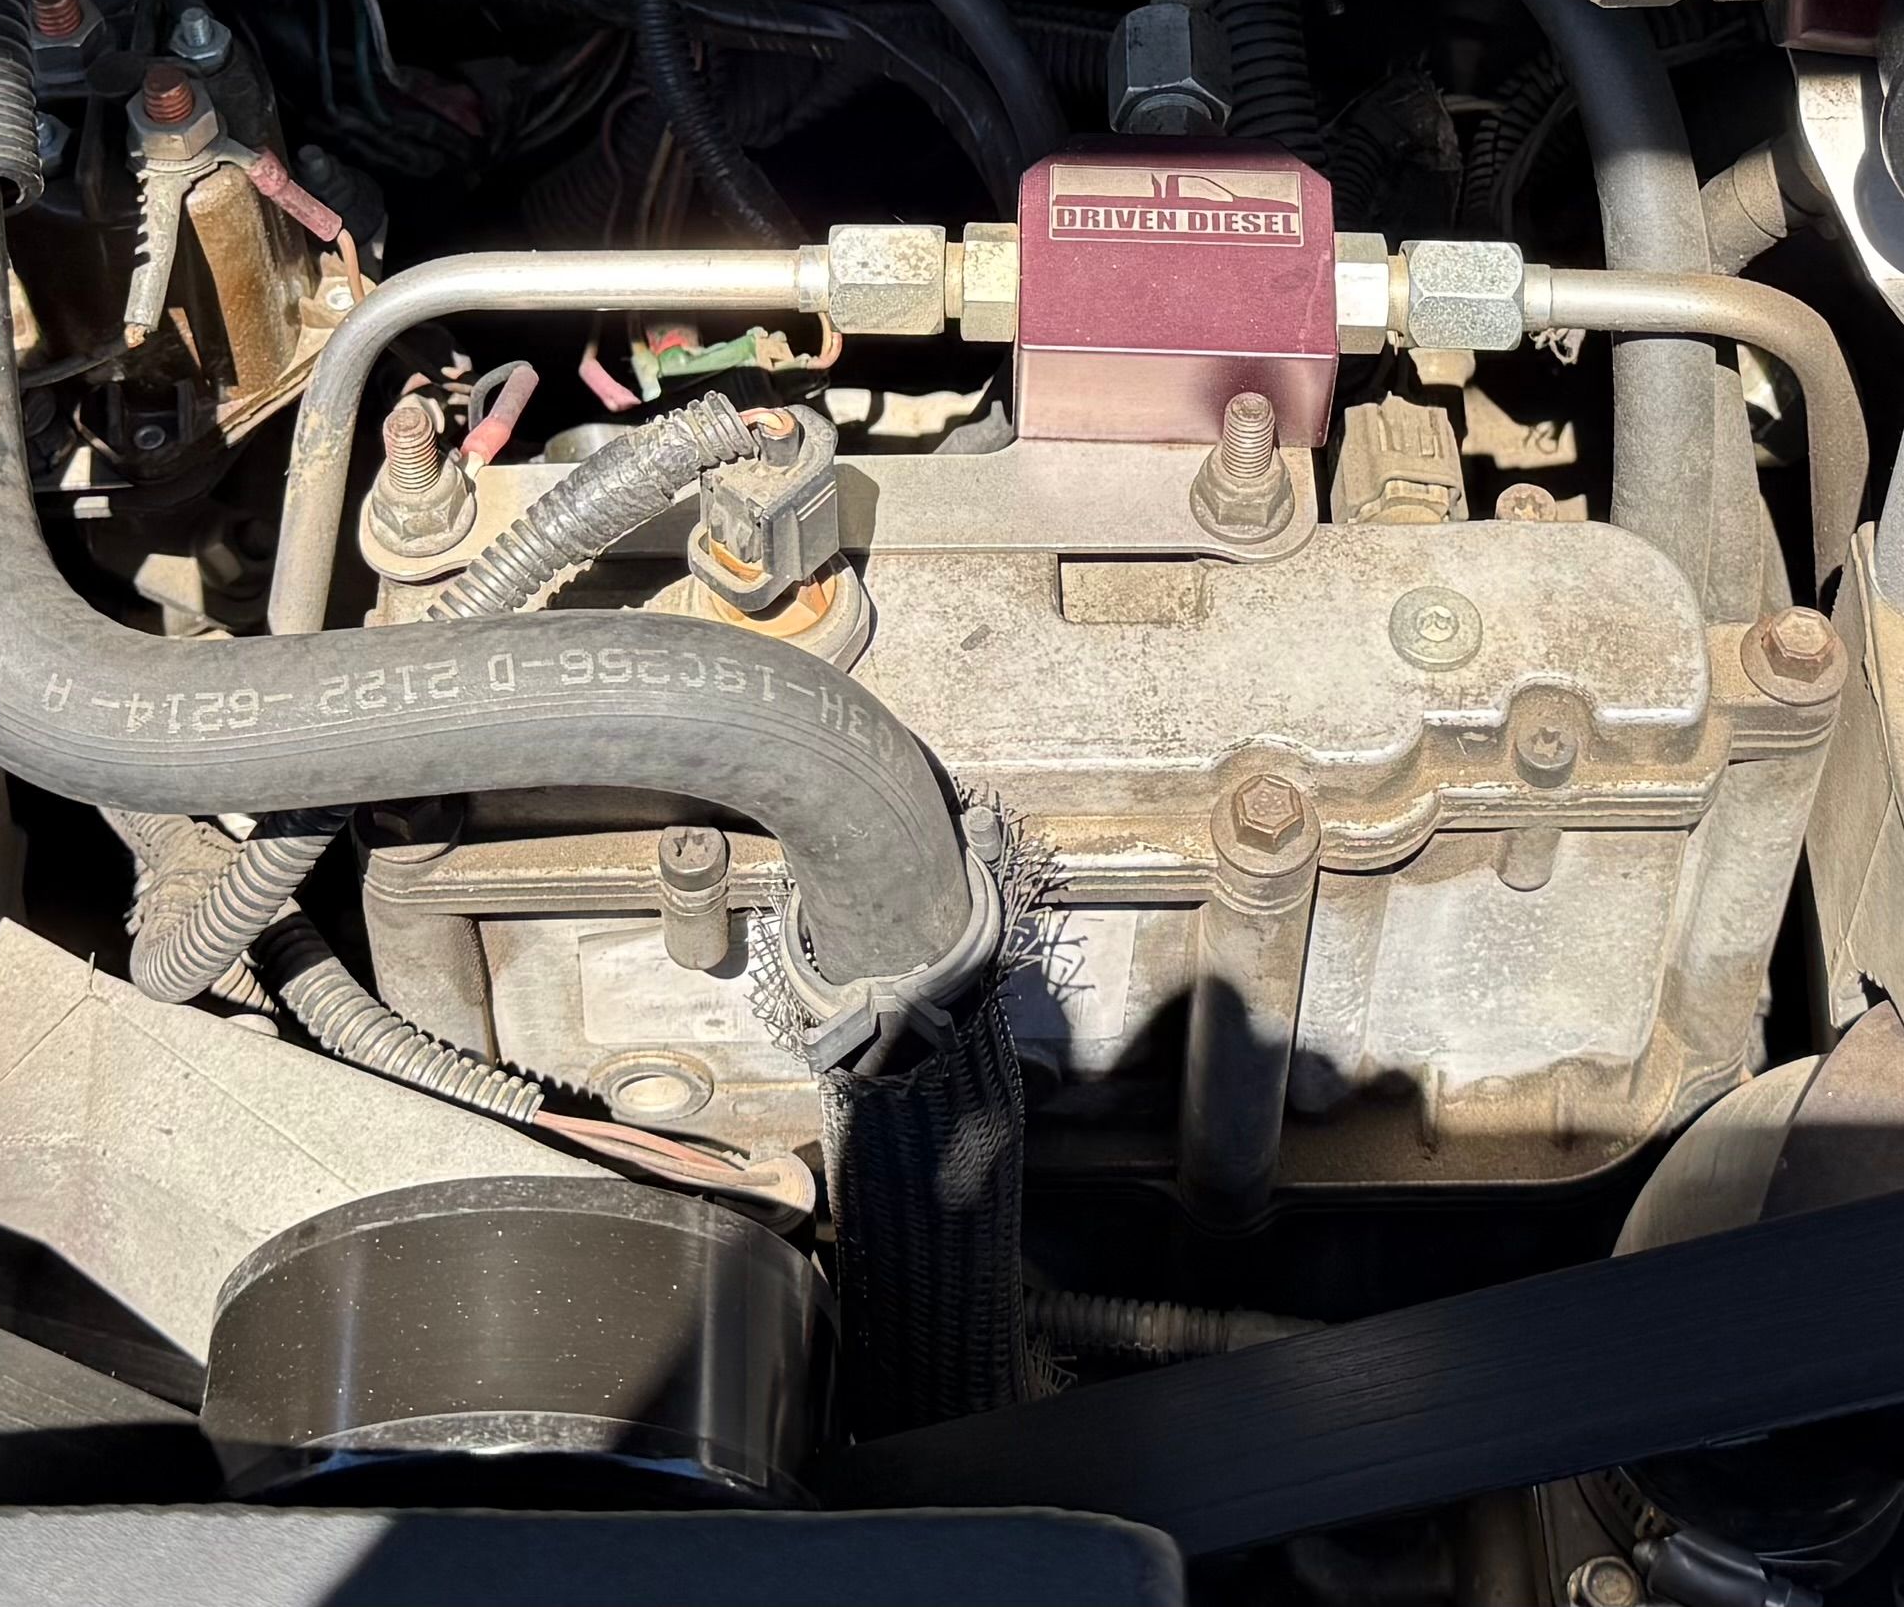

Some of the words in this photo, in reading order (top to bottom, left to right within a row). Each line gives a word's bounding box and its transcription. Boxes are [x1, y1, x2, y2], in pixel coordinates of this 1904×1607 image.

[1055, 207, 1177, 230] DRIVEN
[1187, 211, 1297, 234] DIESEL
[318, 658, 460, 715] 2122
